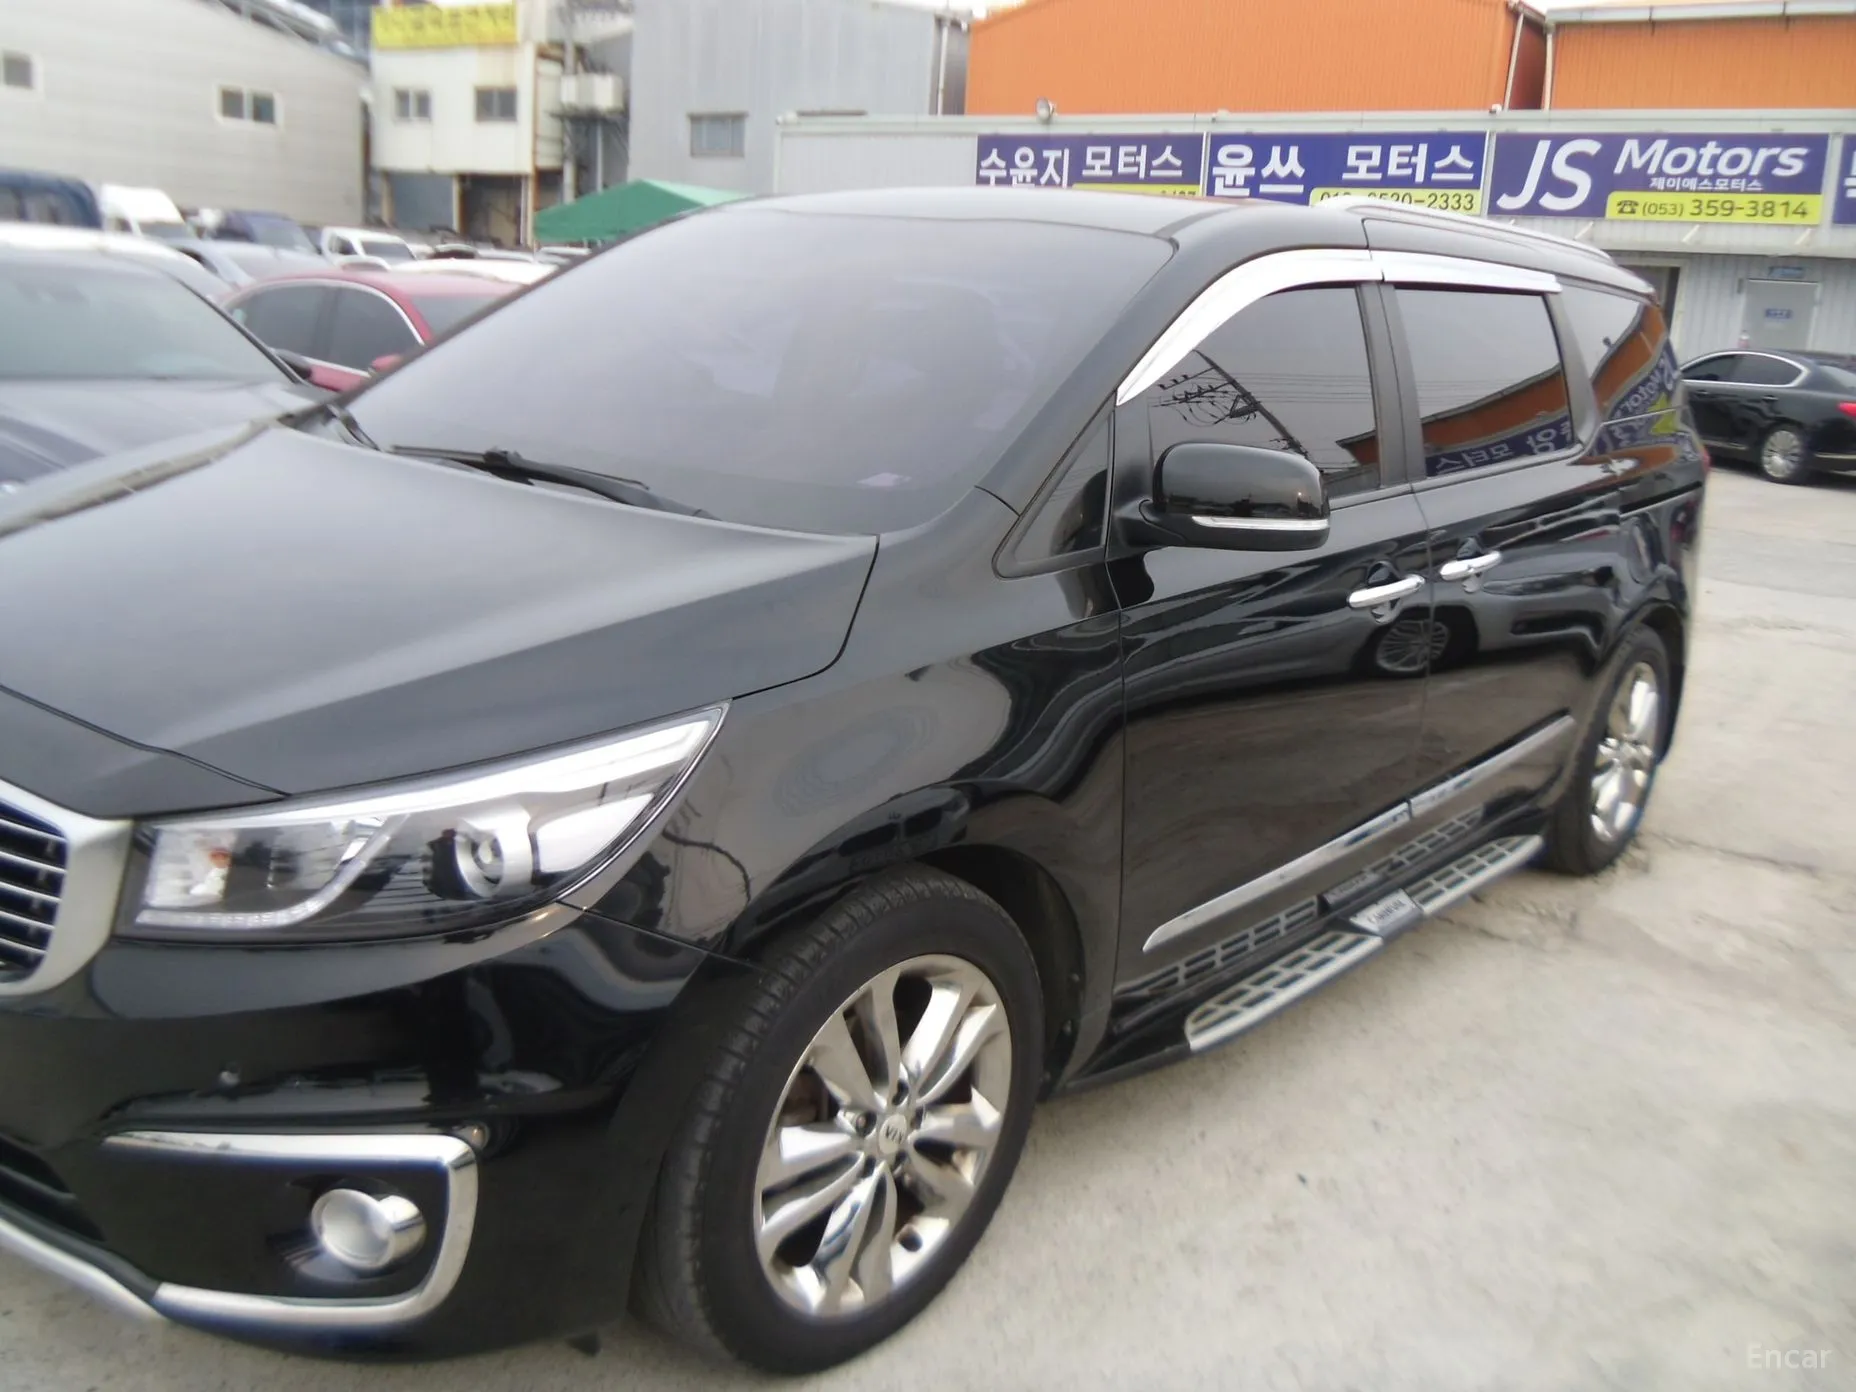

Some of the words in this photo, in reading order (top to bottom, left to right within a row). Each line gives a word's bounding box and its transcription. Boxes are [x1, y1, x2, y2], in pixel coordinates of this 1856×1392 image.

[979, 146, 1070, 188] 수윤지
[1082, 144, 1183, 179] 모터스
[1212, 144, 1306, 197] 윤쓰
[1341, 143, 1475, 184] 모터스
[1496, 138, 1602, 211] JS
[1613, 138, 1809, 177] Motors
[1642, 203, 1684, 217] (053)
[1690, 199, 1808, 219] 359-3814
